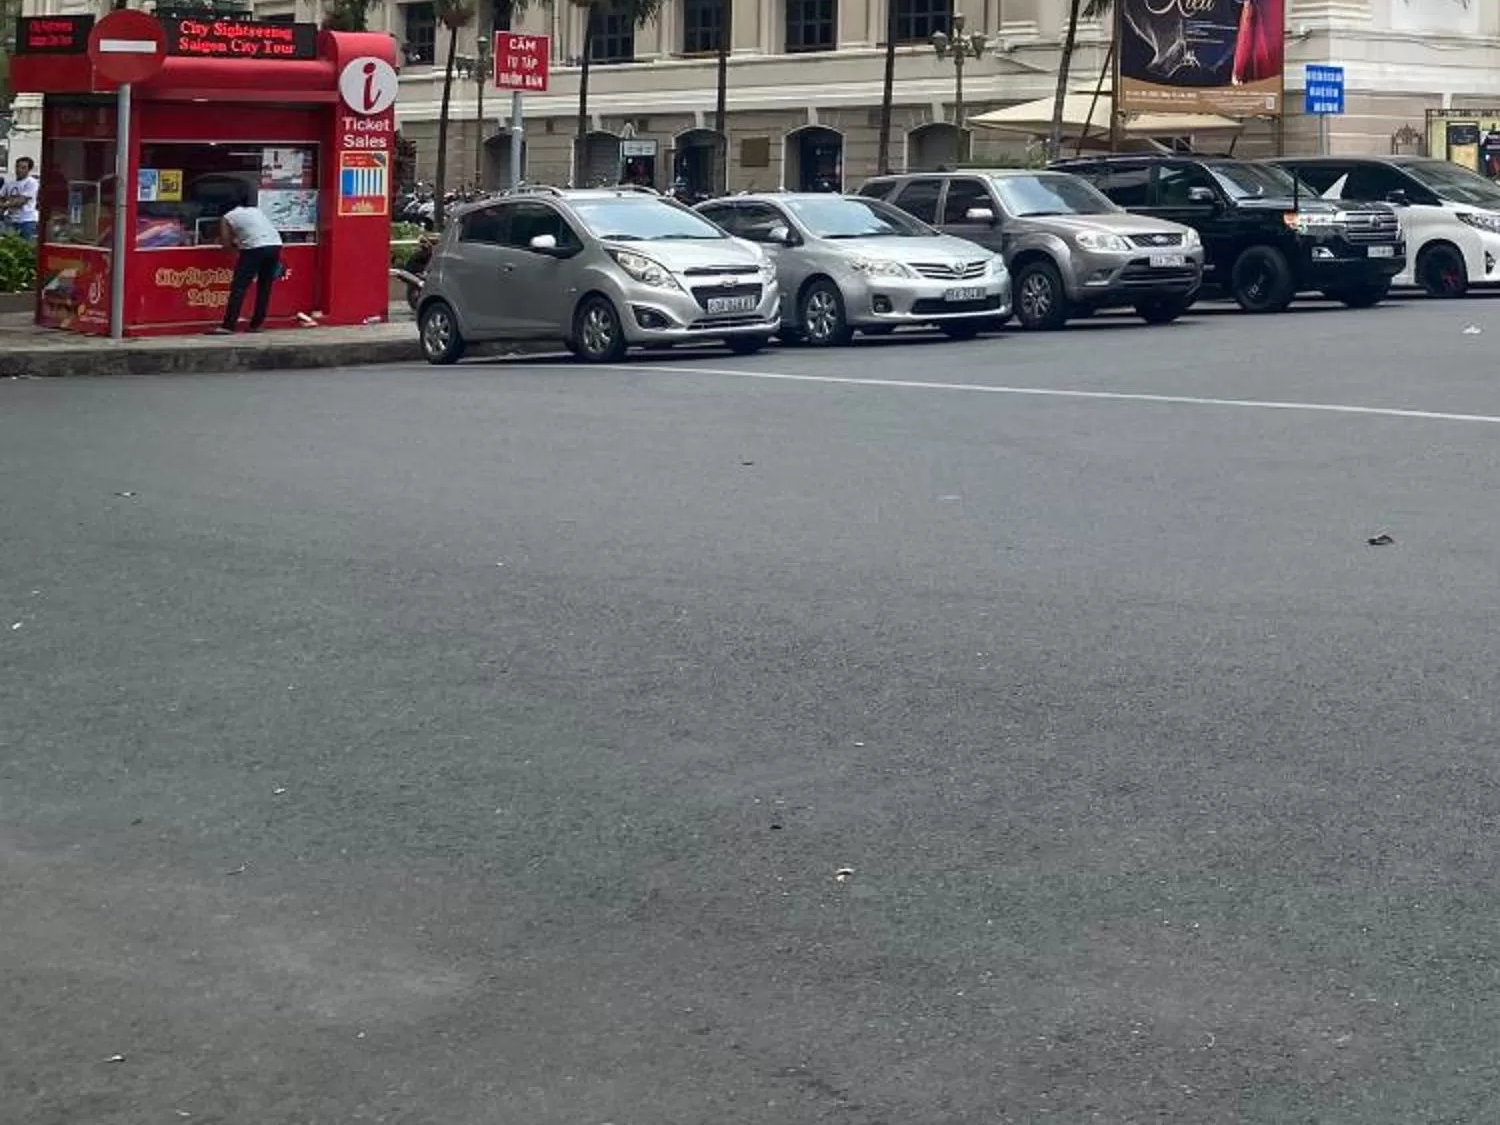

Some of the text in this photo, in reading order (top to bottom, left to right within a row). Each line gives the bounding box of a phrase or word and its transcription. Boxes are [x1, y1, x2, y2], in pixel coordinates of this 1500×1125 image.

[180, 20, 293, 40] City Sightseeing
[179, 37, 297, 55] Saigon City Tour
[342, 117, 390, 132] Ticket
[343, 135, 387, 148] Sales
